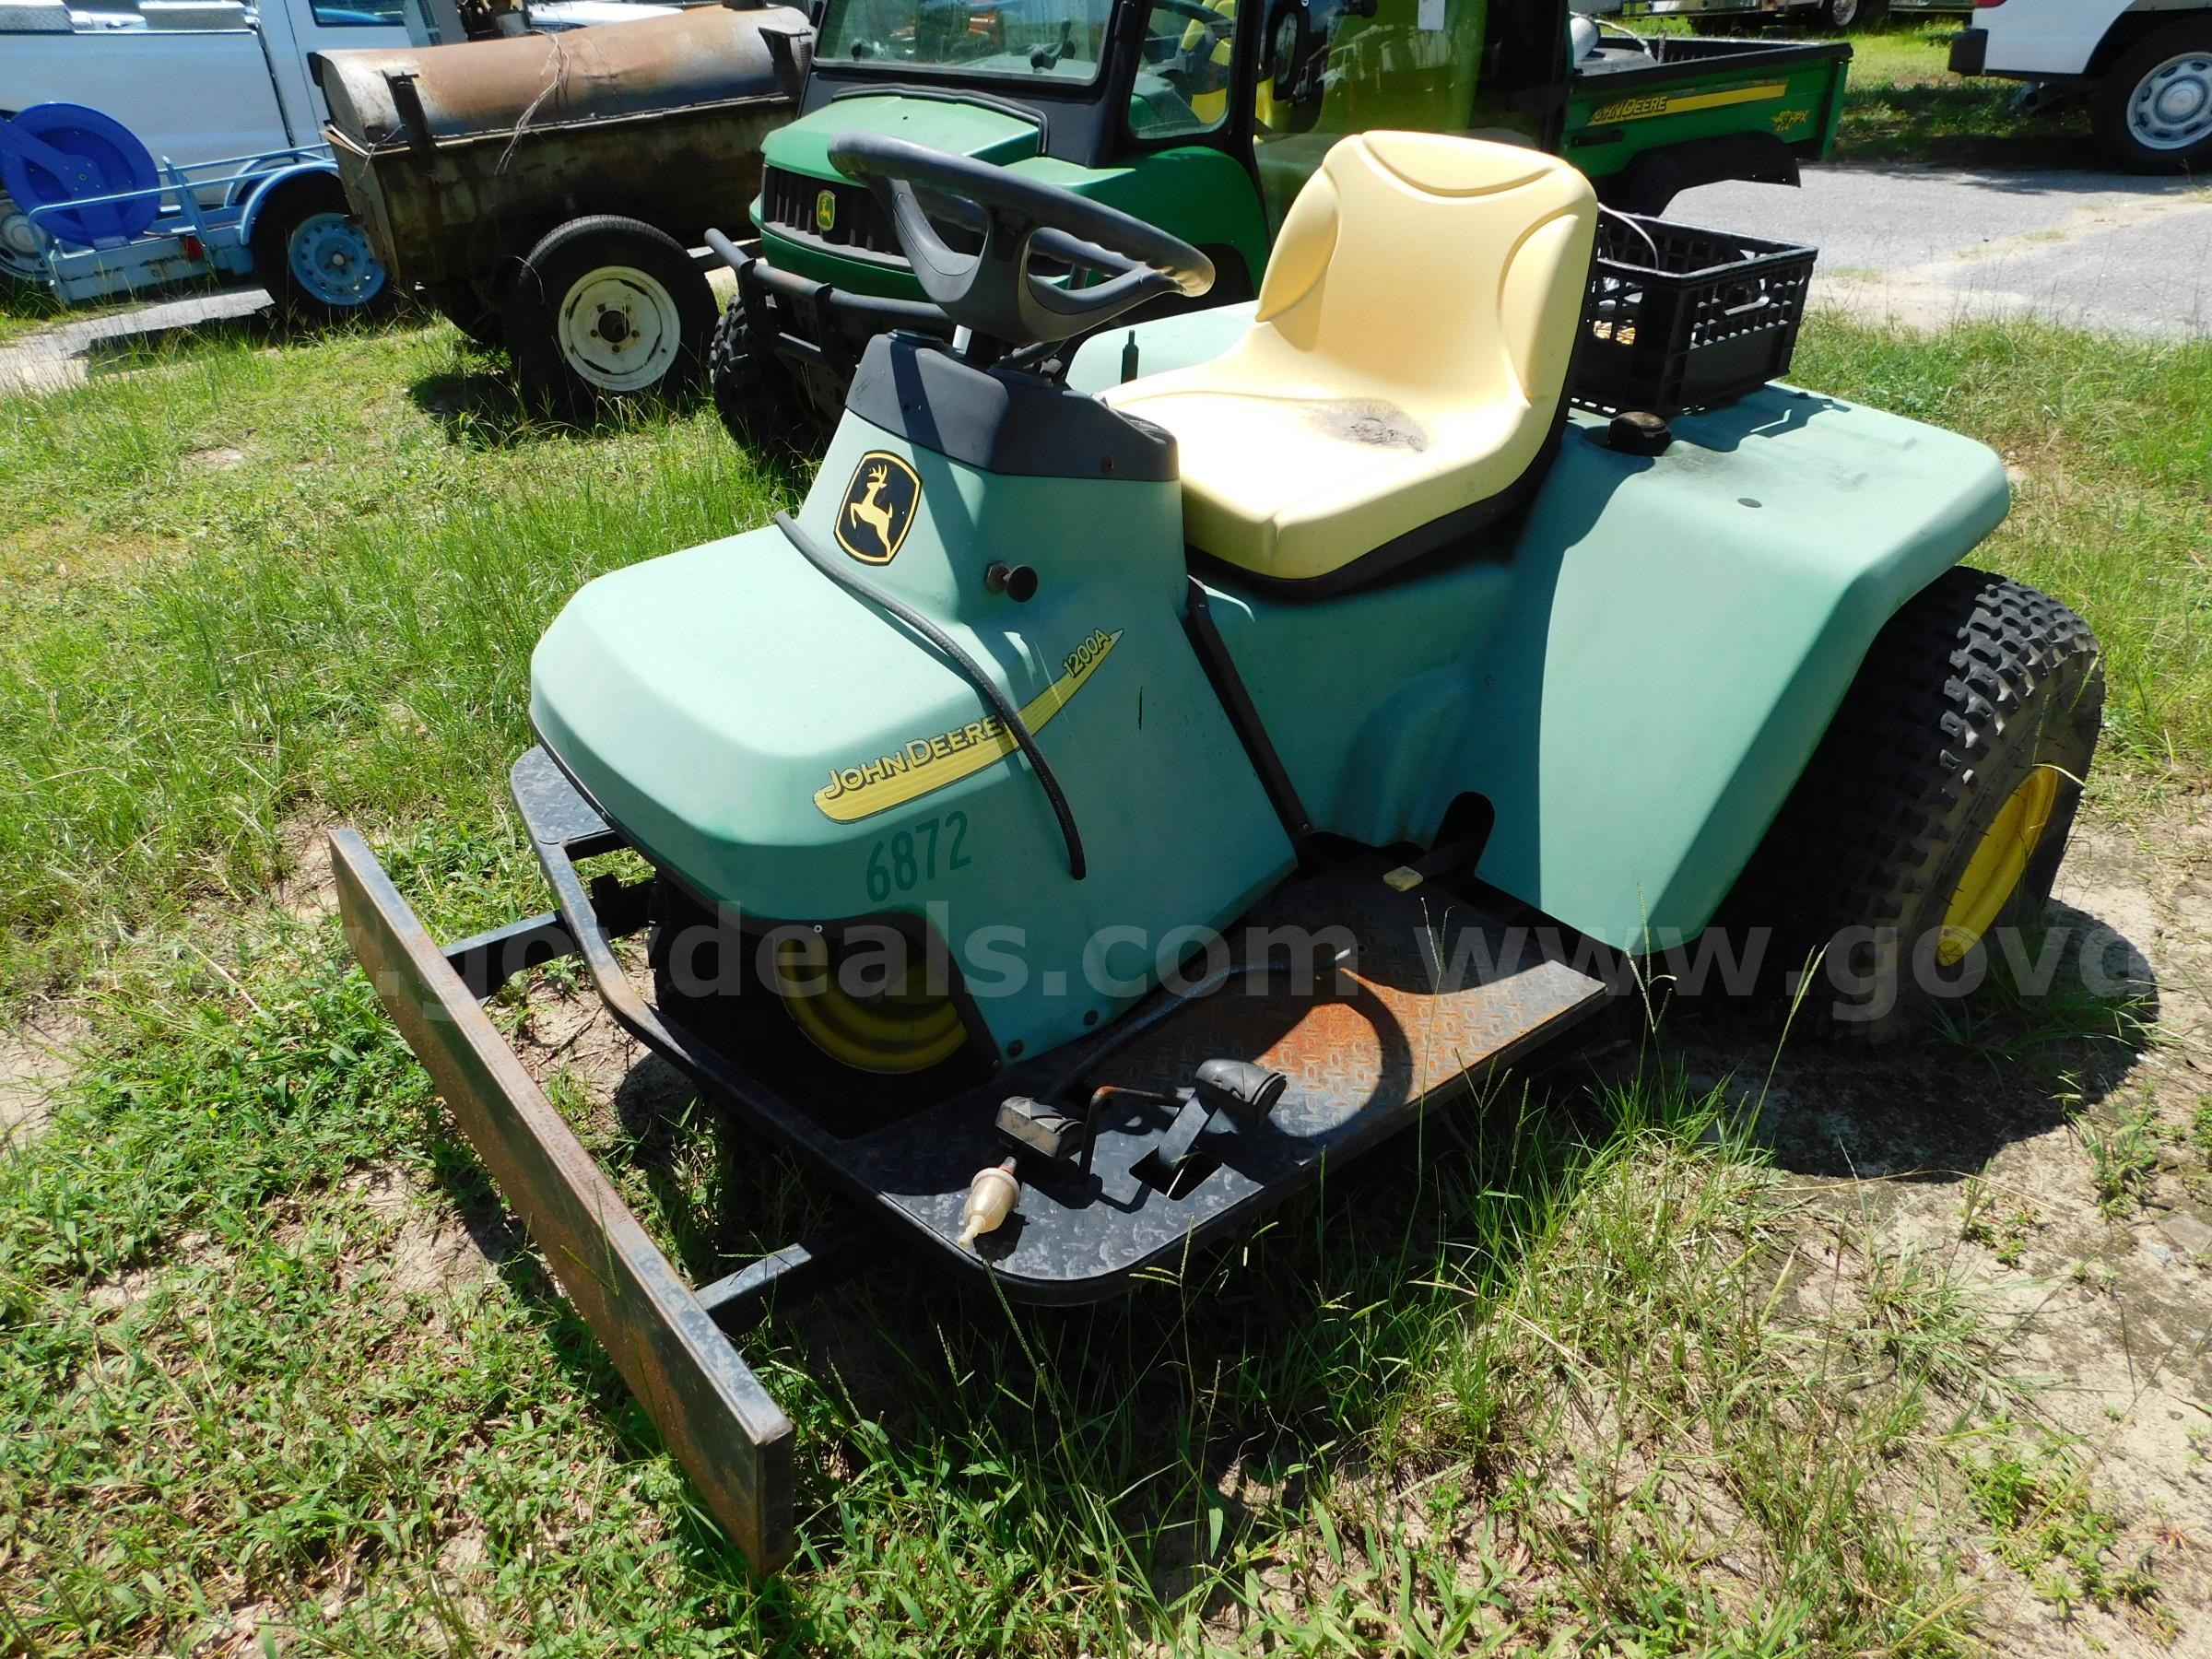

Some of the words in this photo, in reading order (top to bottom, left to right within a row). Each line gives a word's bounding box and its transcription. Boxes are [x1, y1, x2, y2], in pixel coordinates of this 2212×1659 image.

[1621, 96, 1667, 117] DEERE
[1062, 628, 1112, 678] 1200A
[824, 751, 910, 800] JOHN
[904, 715, 1006, 769] DEERE
[865, 809, 971, 902] 6872
